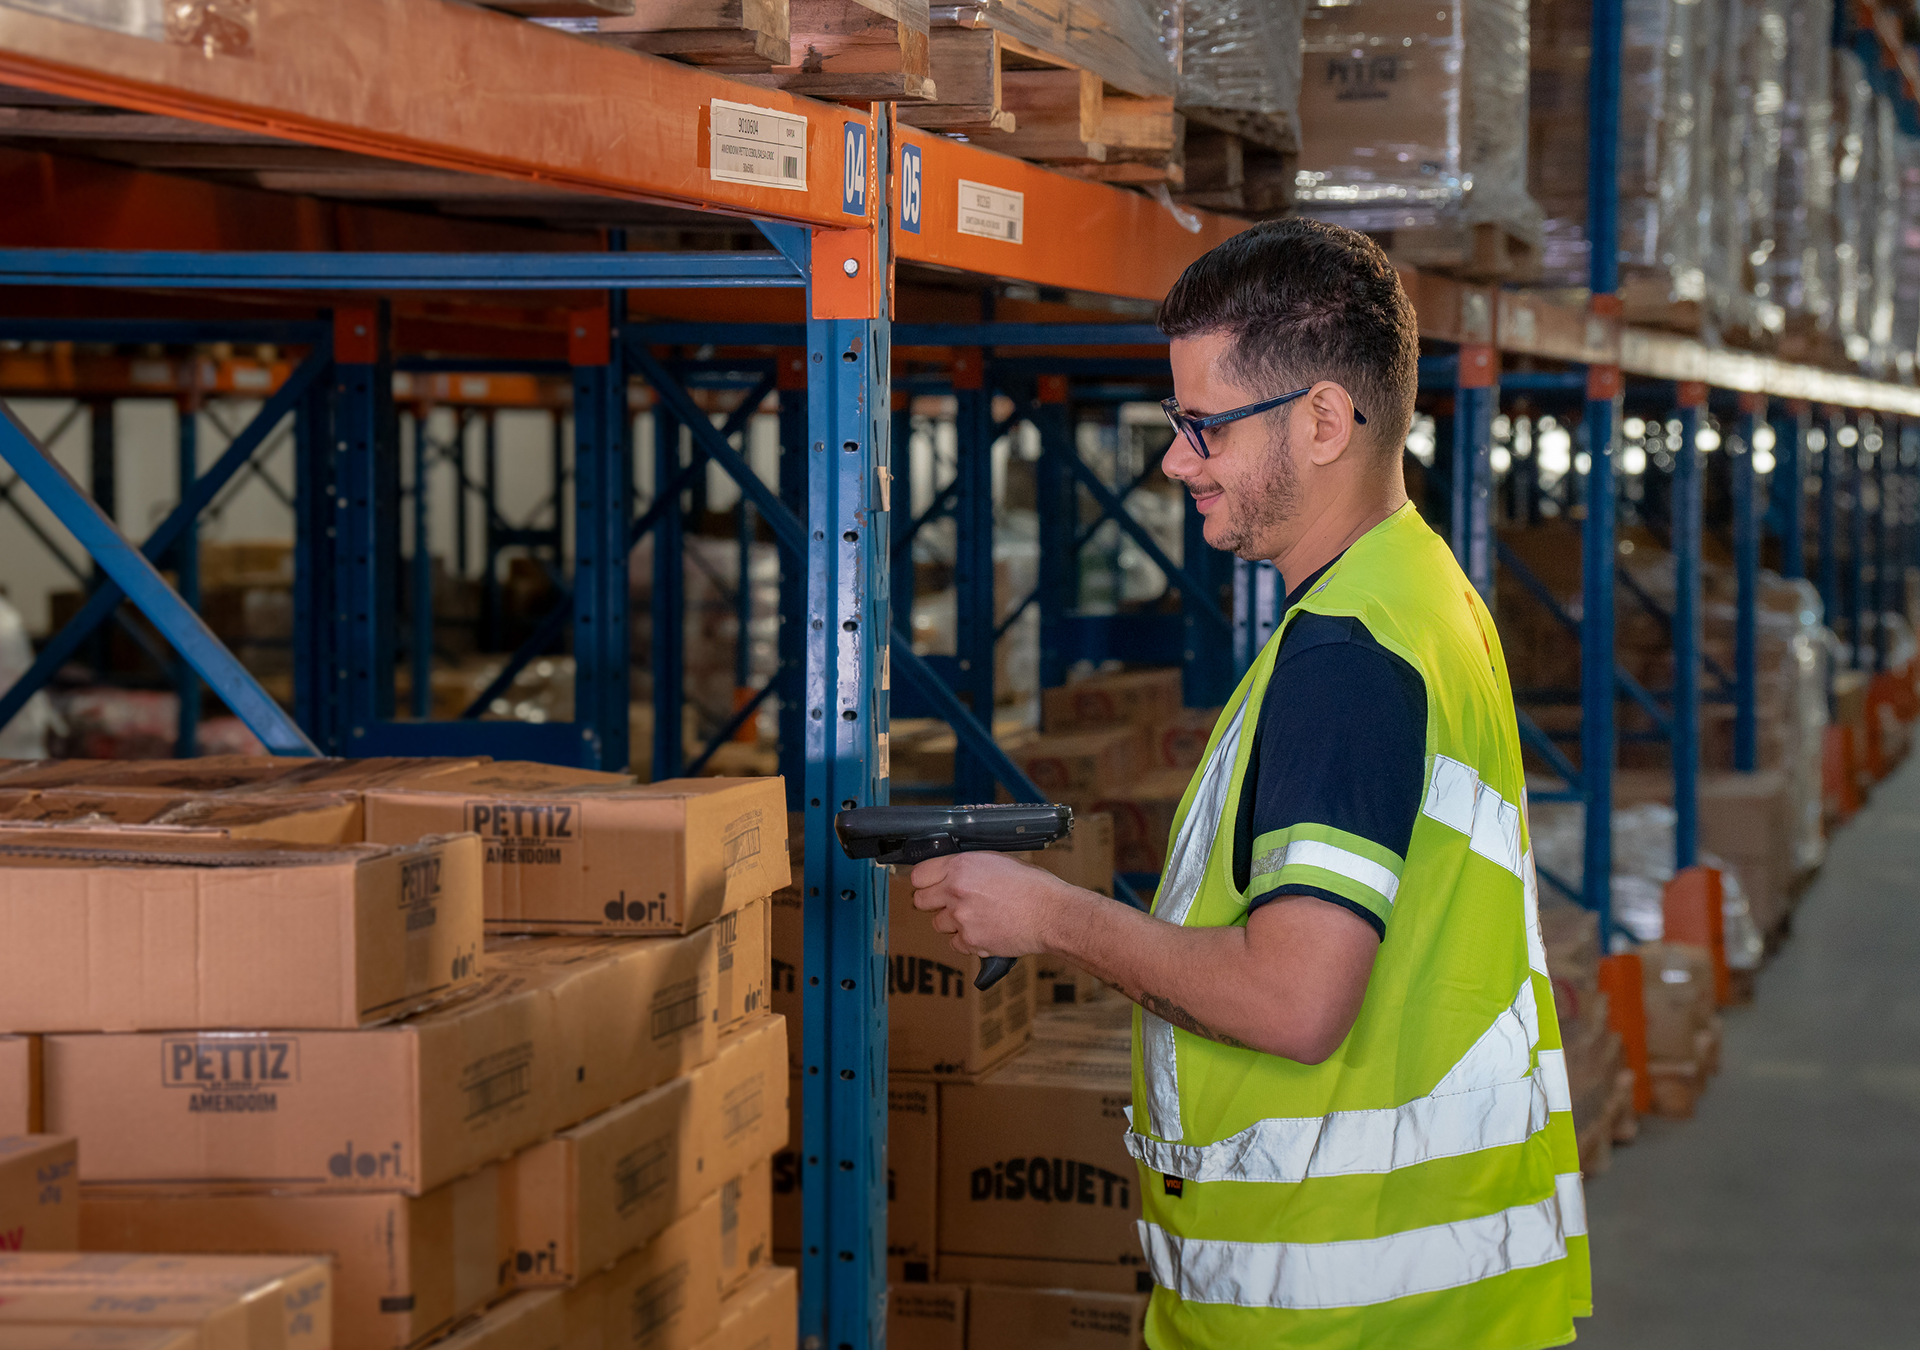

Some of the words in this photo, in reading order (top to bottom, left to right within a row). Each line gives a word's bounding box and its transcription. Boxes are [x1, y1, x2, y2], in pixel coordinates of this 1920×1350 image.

[737, 117, 759, 136] 9010604
[845, 130, 865, 206] 04
[902, 151, 920, 225] 05
[473, 805, 572, 837] PETTIZ
[486, 847, 562, 865] AMENDOIM
[172, 1043, 290, 1081] PETTIZ
[188, 1093, 278, 1113] AMENDOIM
